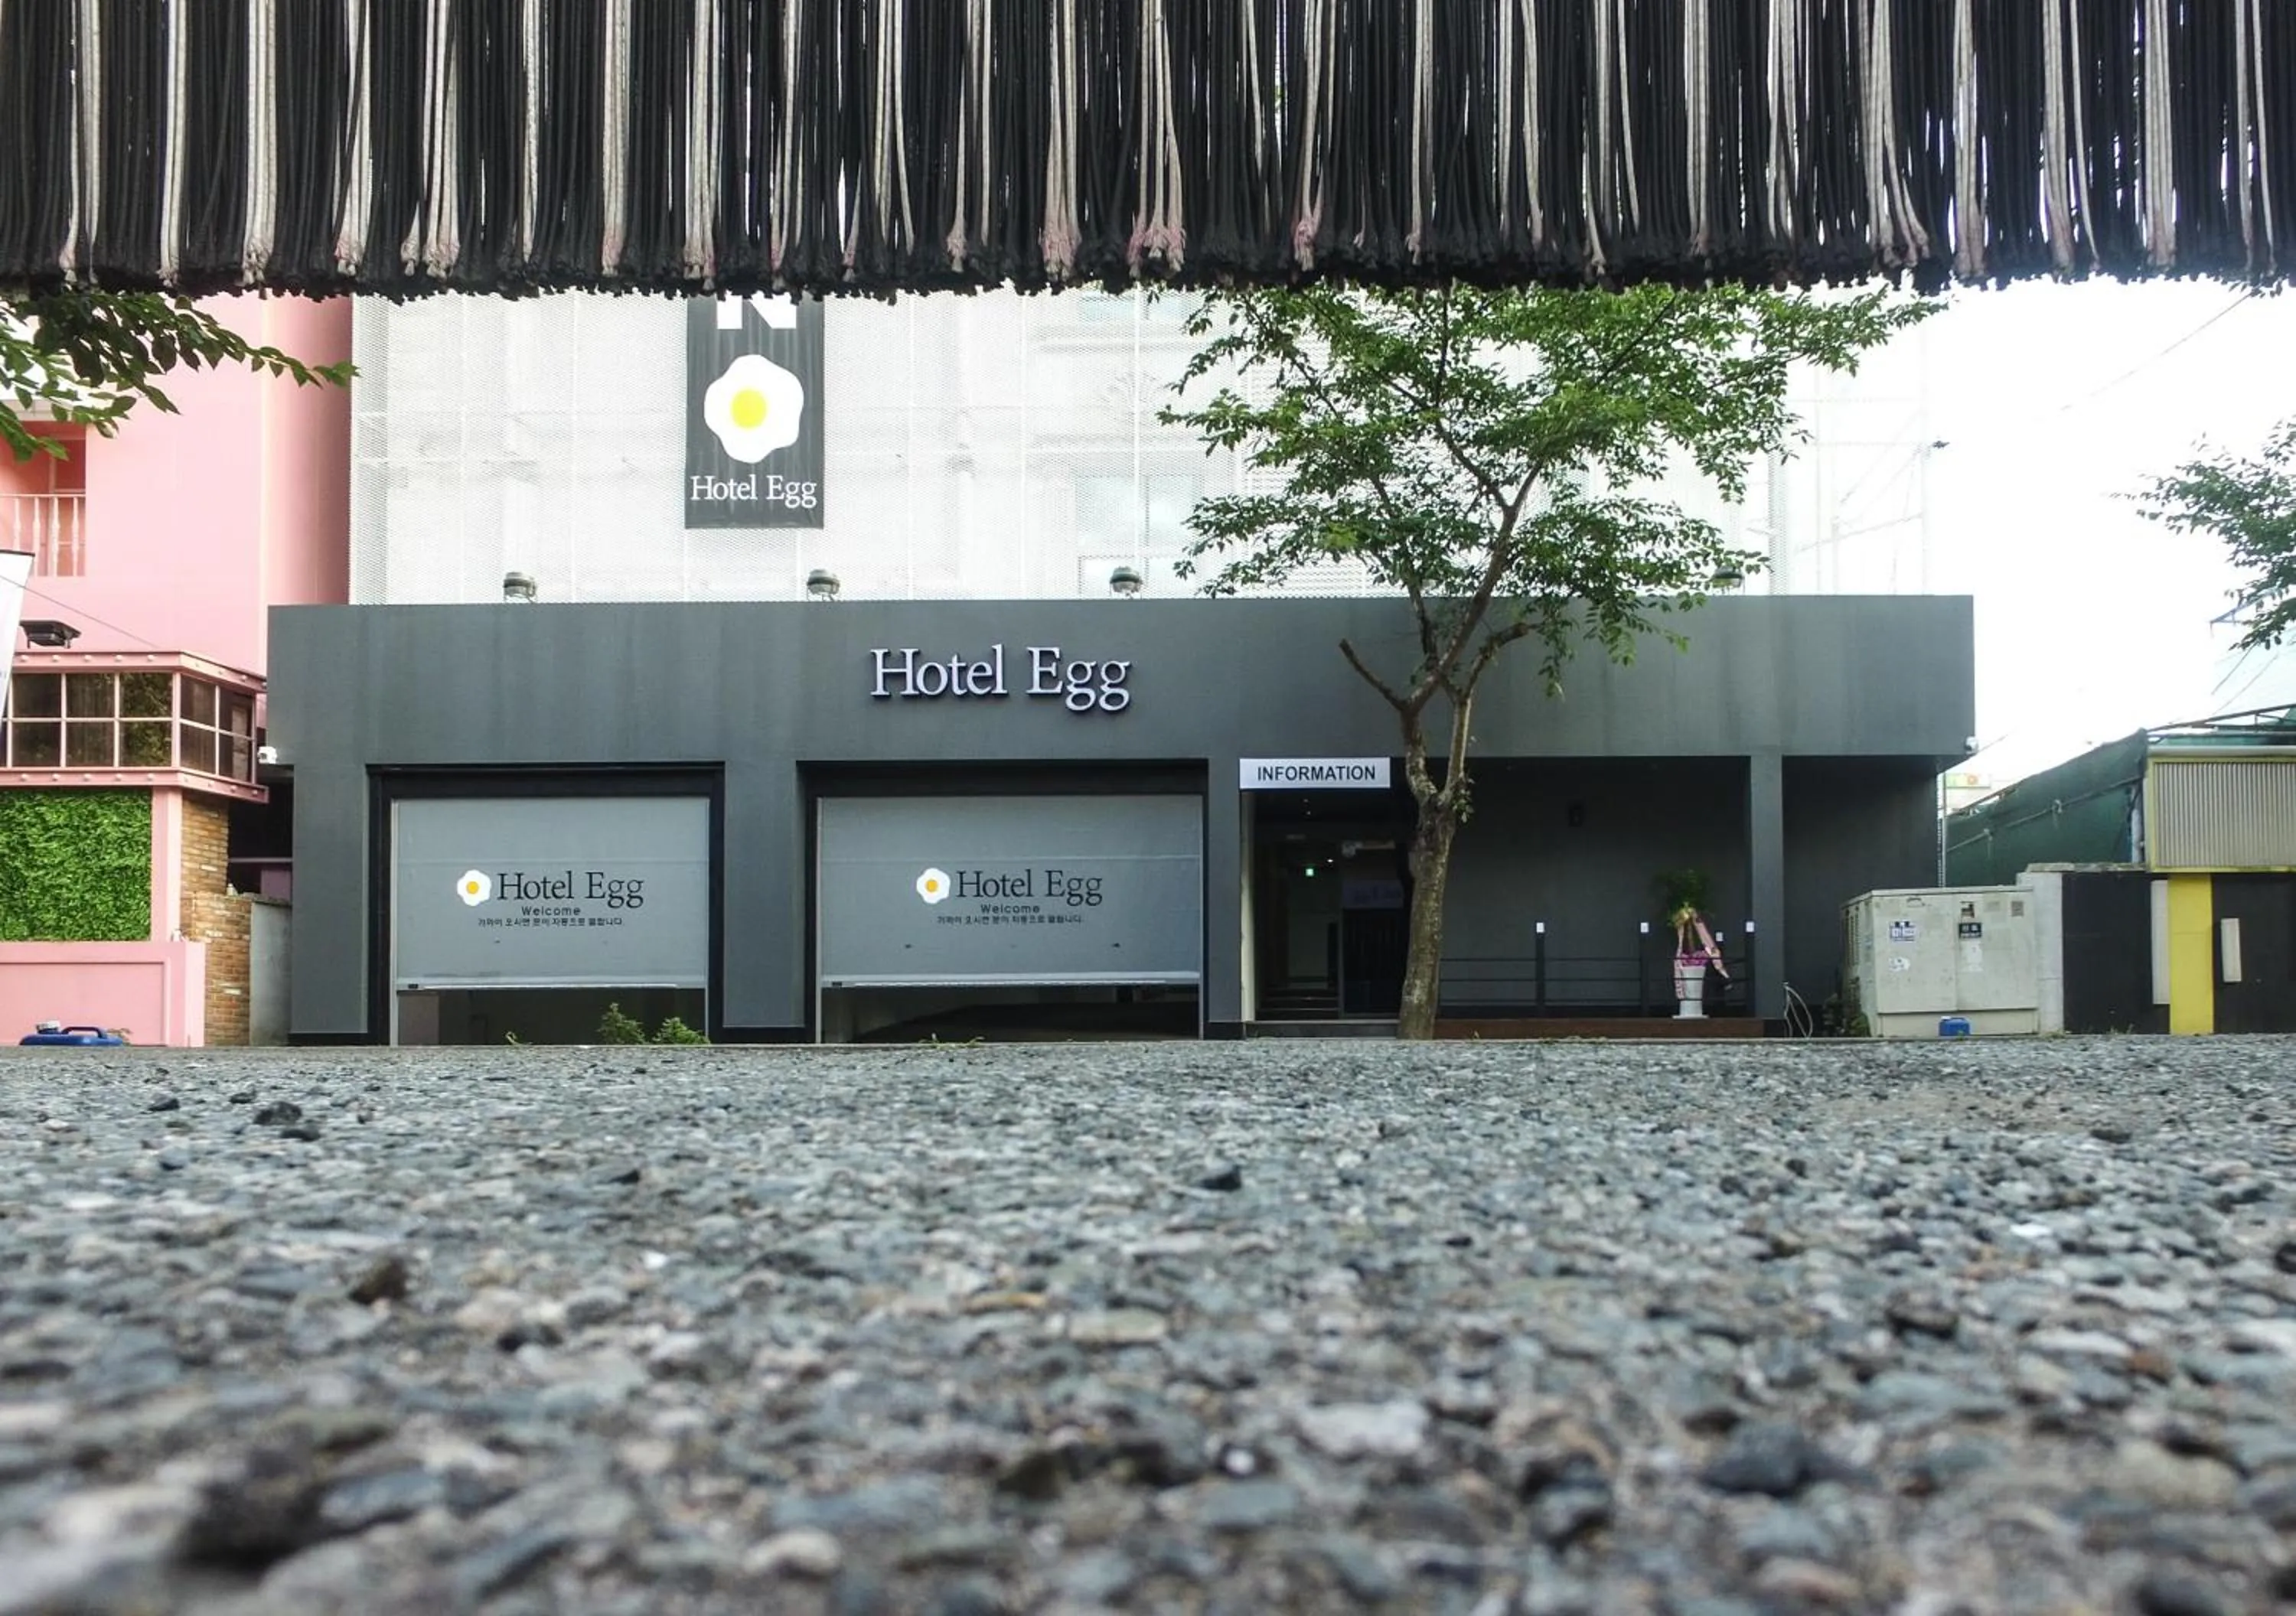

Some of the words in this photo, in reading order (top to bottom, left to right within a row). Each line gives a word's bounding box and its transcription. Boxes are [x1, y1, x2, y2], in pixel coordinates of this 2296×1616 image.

[690, 474, 758, 501] Hotel
[765, 475, 817, 508] Egg
[870, 643, 1009, 697] Hotel
[1026, 647, 1130, 712] Egg
[1257, 766, 1376, 781] INFORMATION
[497, 870, 575, 901] Hotel
[585, 872, 644, 909] Egg
[956, 868, 1035, 898] Hotel
[1045, 869, 1104, 907] Egg
[521, 906, 581, 917] Welcome
[980, 903, 1040, 914] Welcome
